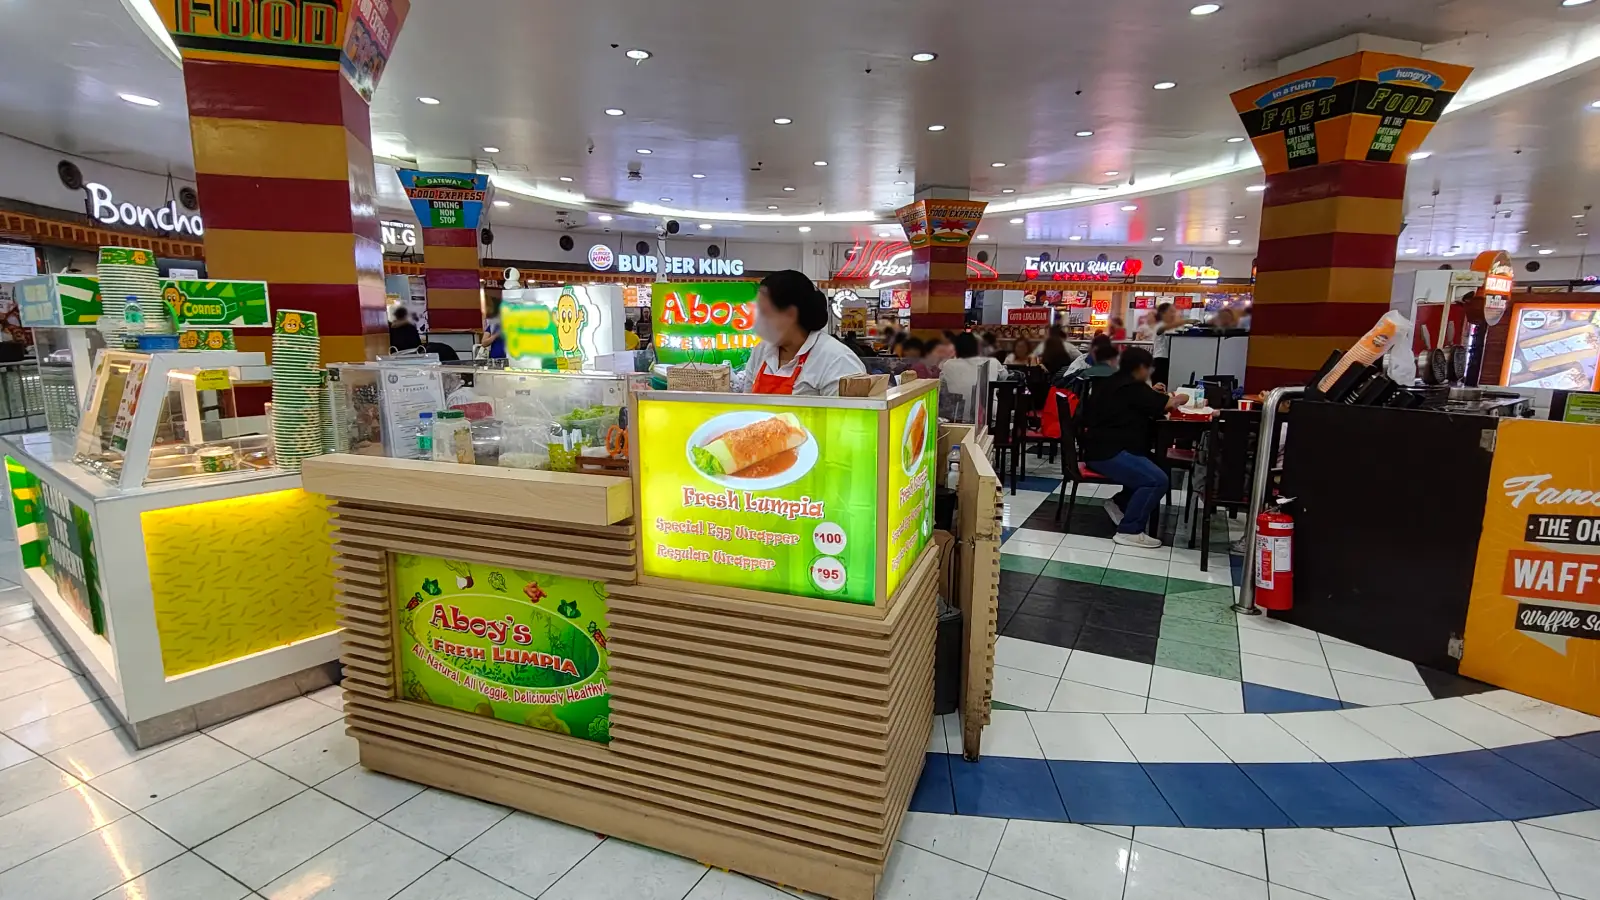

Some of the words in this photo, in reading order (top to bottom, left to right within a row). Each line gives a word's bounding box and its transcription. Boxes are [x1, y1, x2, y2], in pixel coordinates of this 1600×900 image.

[176, 0, 338, 45] FOOD
[1396, 69, 1432, 82] hungry?
[1290, 80, 1317, 92] rush?
[1366, 88, 1434, 115] FOOD
[1261, 94, 1337, 130] FAST
[1392, 116, 1404, 126] THE
[1288, 126, 1296, 136] AT
[1298, 123, 1311, 133] THE
[1377, 127, 1402, 136] GATEWAY
[1286, 132, 1315, 145] GATEWAY
[1289, 147, 1316, 158] EXPRESS
[1371, 143, 1395, 151] EXPRESS
[427, 178, 462, 186] GATEWAY
[410, 188, 435, 199] FOOD
[440, 190, 482, 200] EXPRESS
[86, 182, 204, 236] Boncho
[433, 201, 460, 209] DINING
[439, 209, 455, 217] NON
[439, 216, 457, 224] STOP
[928, 209, 947, 217] FOOD
[949, 210, 984, 219] EXPRESS
[699, 258, 744, 276] KING
[1040, 261, 1085, 273] KYUKYU
[1087, 260, 1126, 275] RAMEN
[659, 291, 757, 331] Aboy
[682, 486, 740, 512] Fresh
[744, 492, 826, 520] Lumpia
[655, 517, 704, 537] Special
[707, 522, 732, 541] Egg
[735, 525, 800, 546] Wrapper
[1538, 518, 1572, 537] THE
[656, 544, 710, 562] Regular
[712, 550, 777, 571] Wrapper
[429, 603, 532, 646] Aboy's
[1520, 609, 1581, 633] Waffle
[432, 637, 485, 661] FRESH
[492, 646, 580, 678] LUMPIA
[411, 643, 461, 685] All-Natural,
[463, 675, 476, 690] All
[475, 680, 512, 703] Veggie,
[514, 688, 565, 706] Deliciously
[566, 678, 608, 701] Healthy!
